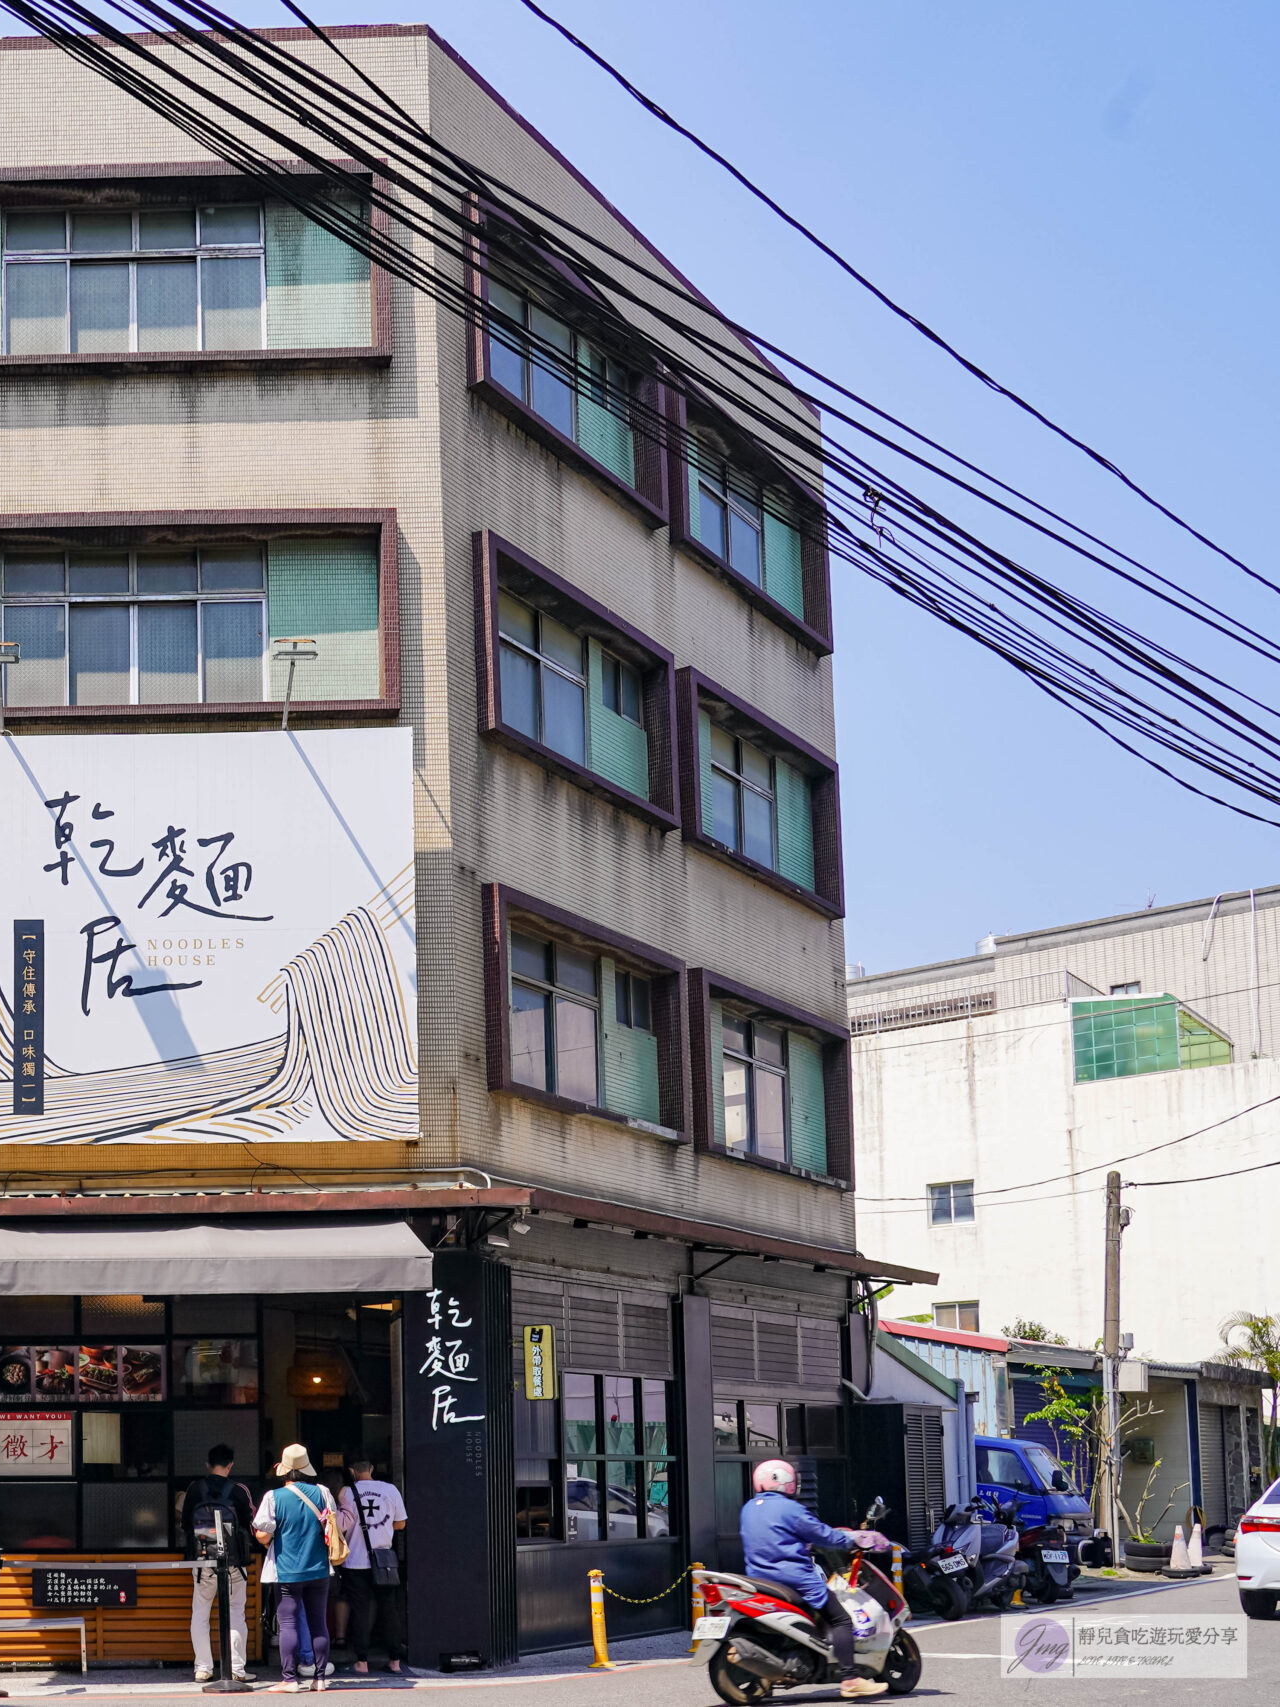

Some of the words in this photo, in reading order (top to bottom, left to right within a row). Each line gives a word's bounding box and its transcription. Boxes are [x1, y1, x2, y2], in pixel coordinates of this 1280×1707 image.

[147, 938, 245, 950] NOODLES
[147, 955, 216, 967] HOUSE
[419, 1288, 485, 1431] 乾麵居
[532, 1345, 544, 1397] 外帶取餐處
[1, 1434, 64, 1461] 徵才
